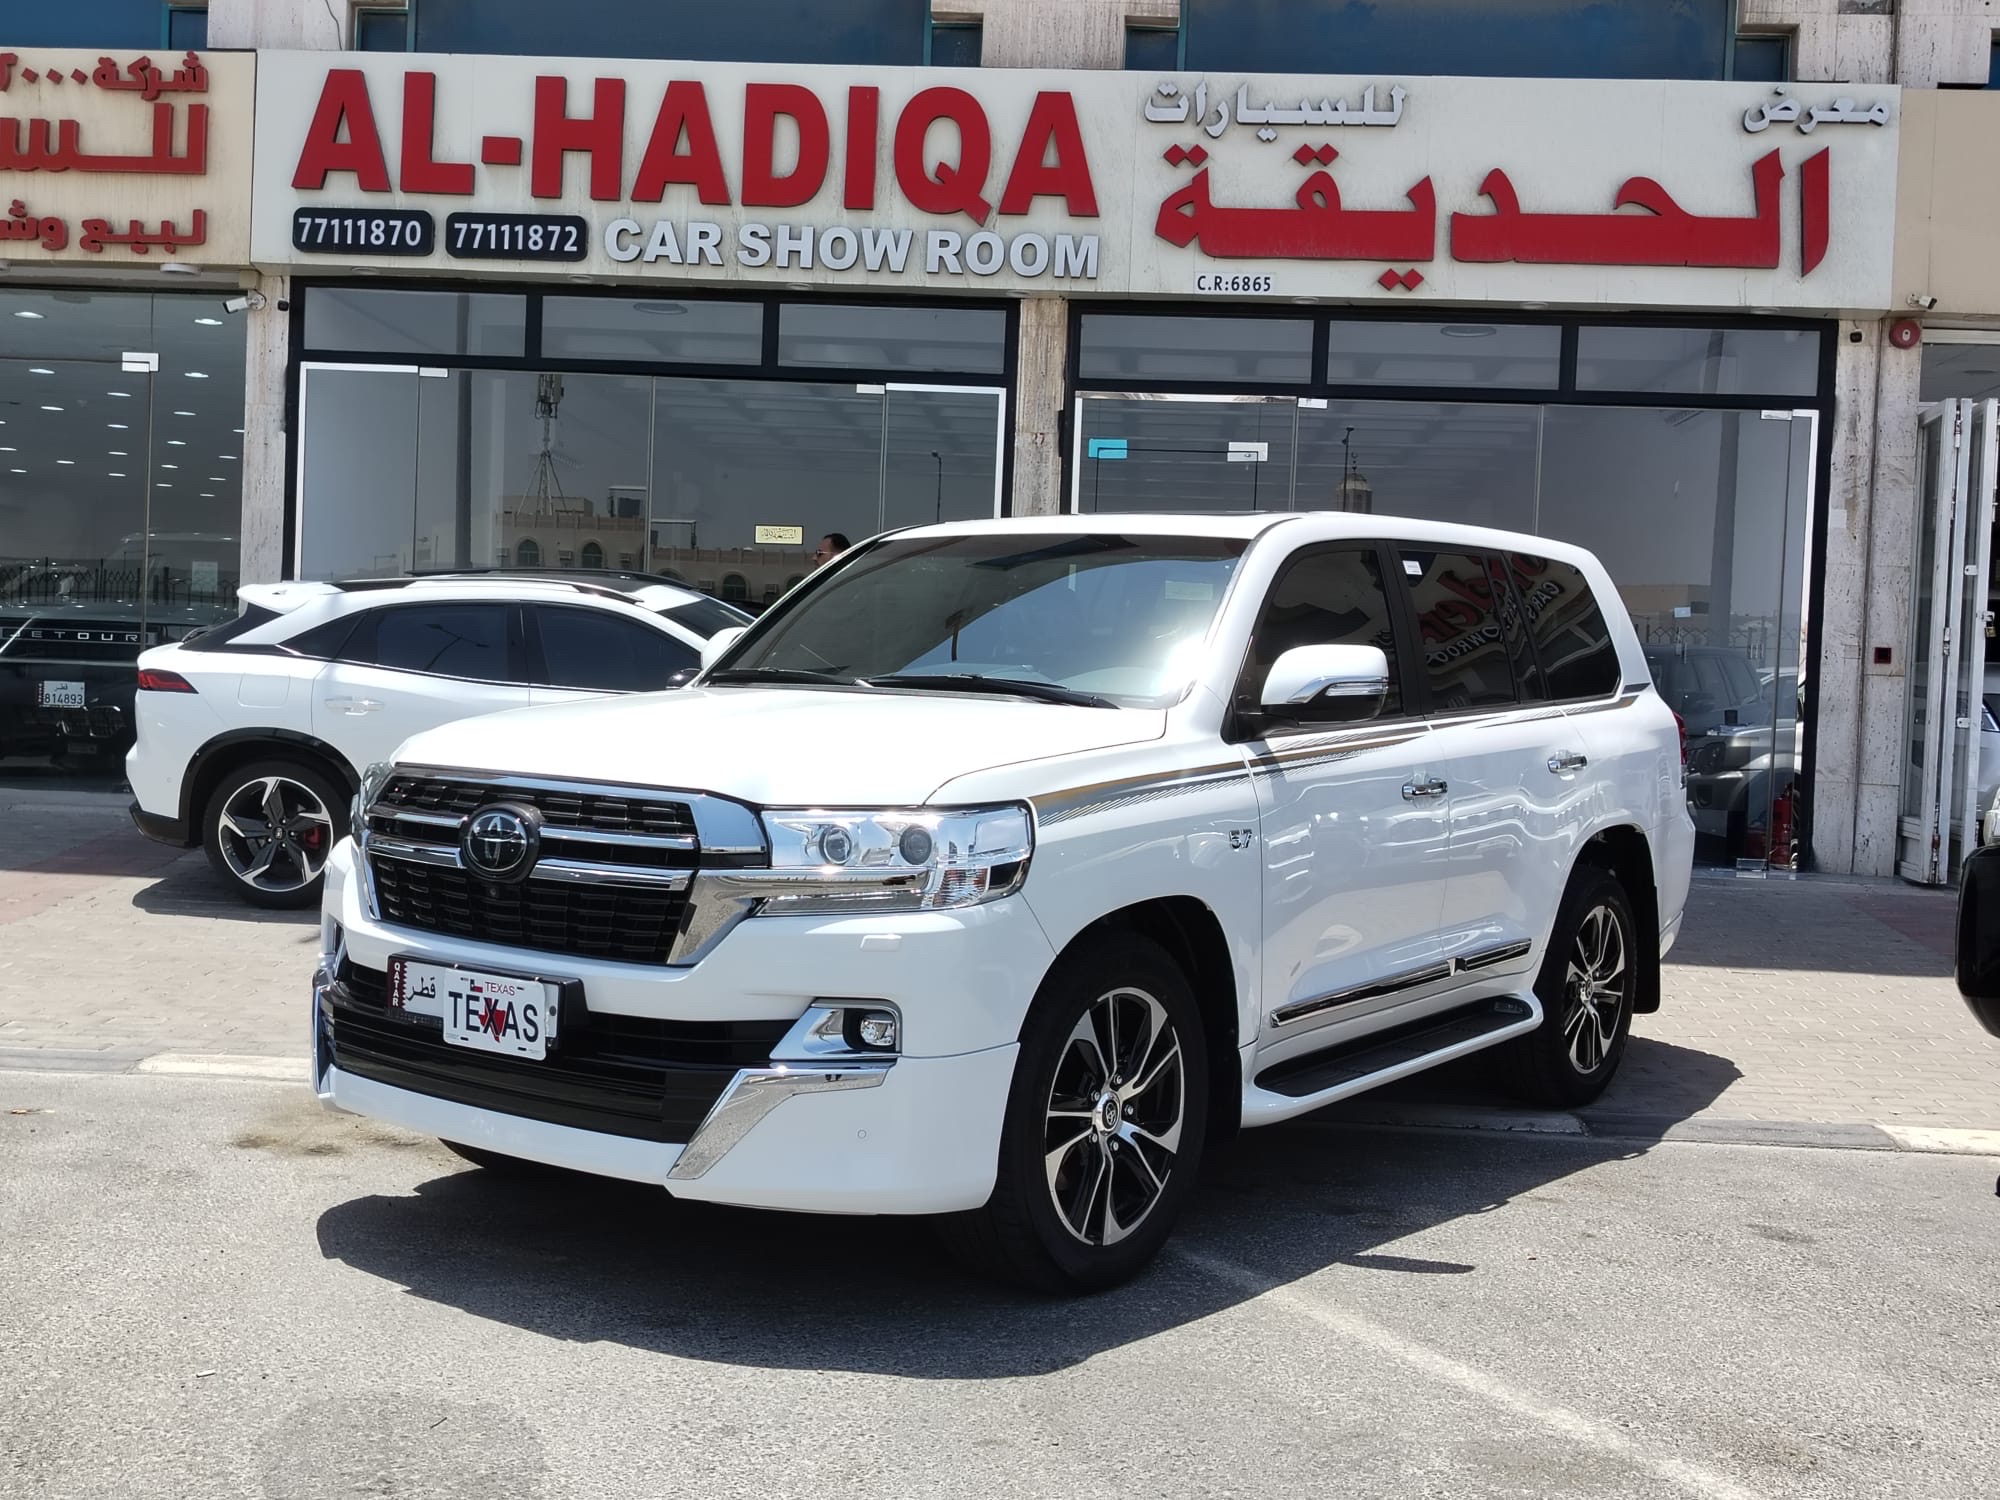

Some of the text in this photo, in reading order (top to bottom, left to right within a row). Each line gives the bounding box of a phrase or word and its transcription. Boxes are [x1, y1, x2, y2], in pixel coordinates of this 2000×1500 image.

[93, 51, 208, 101] شركة
[1143, 82, 1406, 143] للسيارات
[1742, 86, 1891, 134] معرض
[291, 68, 1099, 227] AL-HADIQA
[79, 208, 207, 255] لبيع
[298, 216, 423, 247] 77111870
[453, 222, 579, 253] 77111872
[1154, 142, 1831, 292] الحديقة
[604, 218, 1101, 279] CAR SHOW ROOM
[1197, 275, 1271, 292] C.R:6865
[10, 630, 138, 642] JETOUR
[44, 692, 83, 705] 814893
[406, 976, 436, 1002] قطر
[484, 981, 516, 997] TEXAS
[448, 990, 540, 1043] TEXAS
